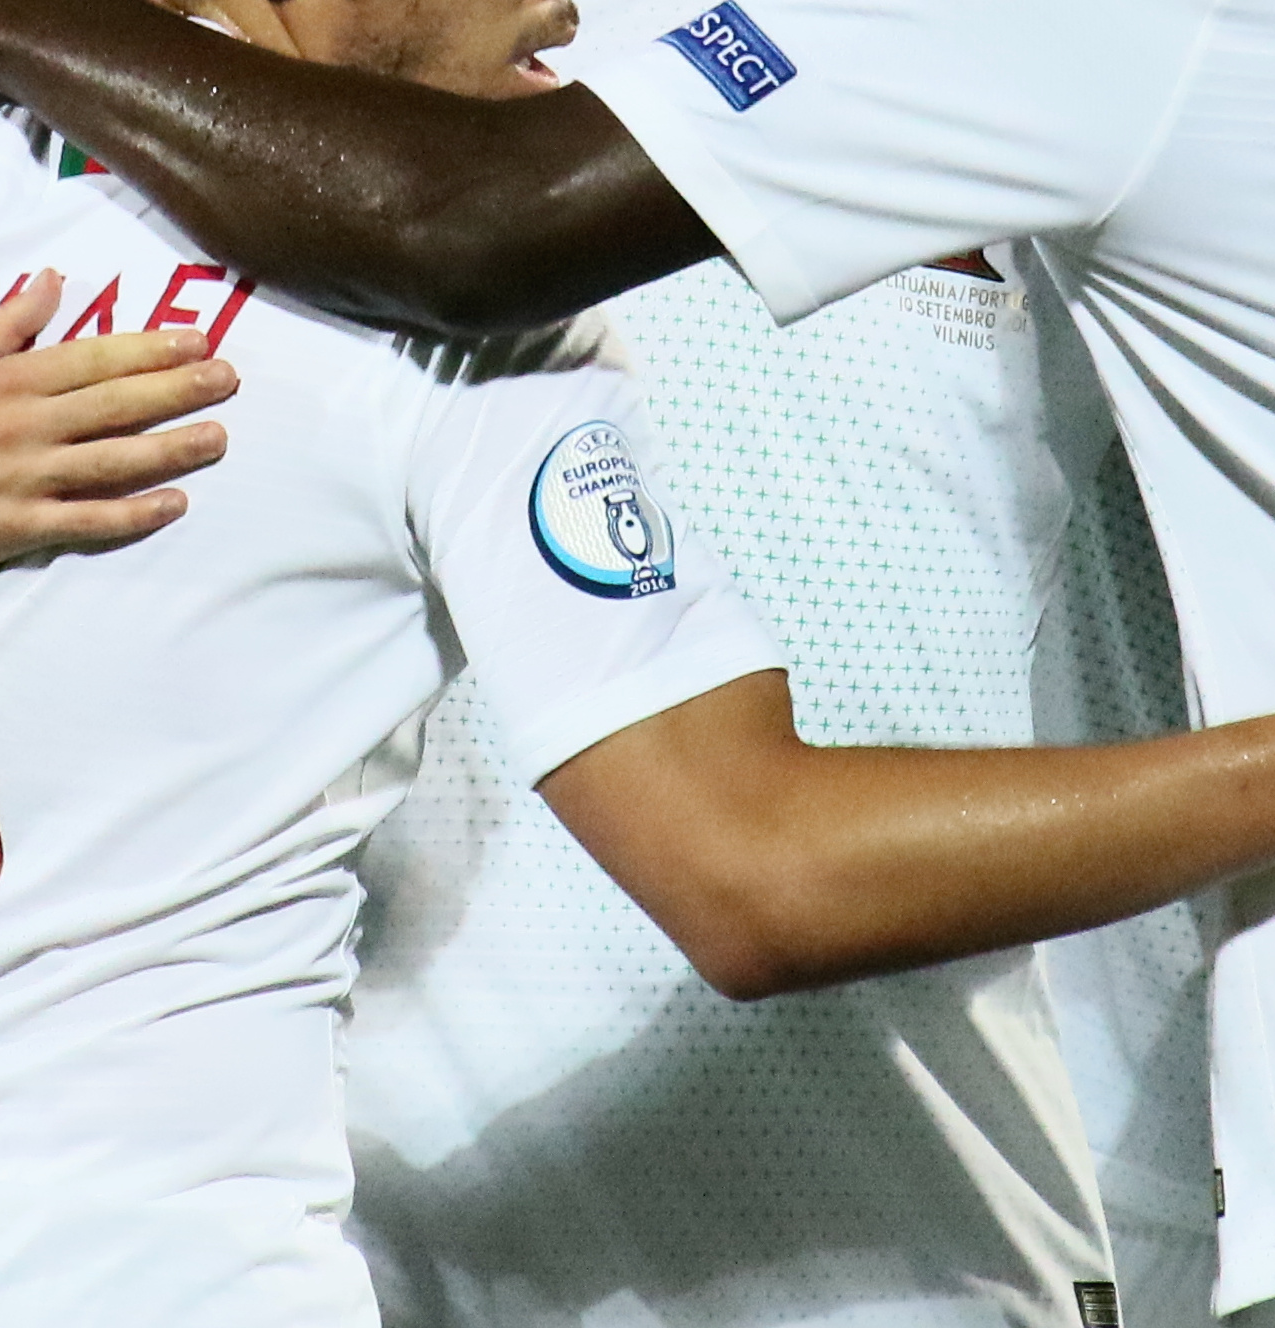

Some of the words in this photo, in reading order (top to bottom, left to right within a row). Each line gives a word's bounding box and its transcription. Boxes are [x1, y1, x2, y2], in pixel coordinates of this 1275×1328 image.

[687, 12, 779, 94] SPECT
[899, 295, 913, 313] 10
[916, 298, 996, 330] SETEMBRO
[933, 324, 996, 351] VILNIUS
[630, 578, 668, 597] 2016
